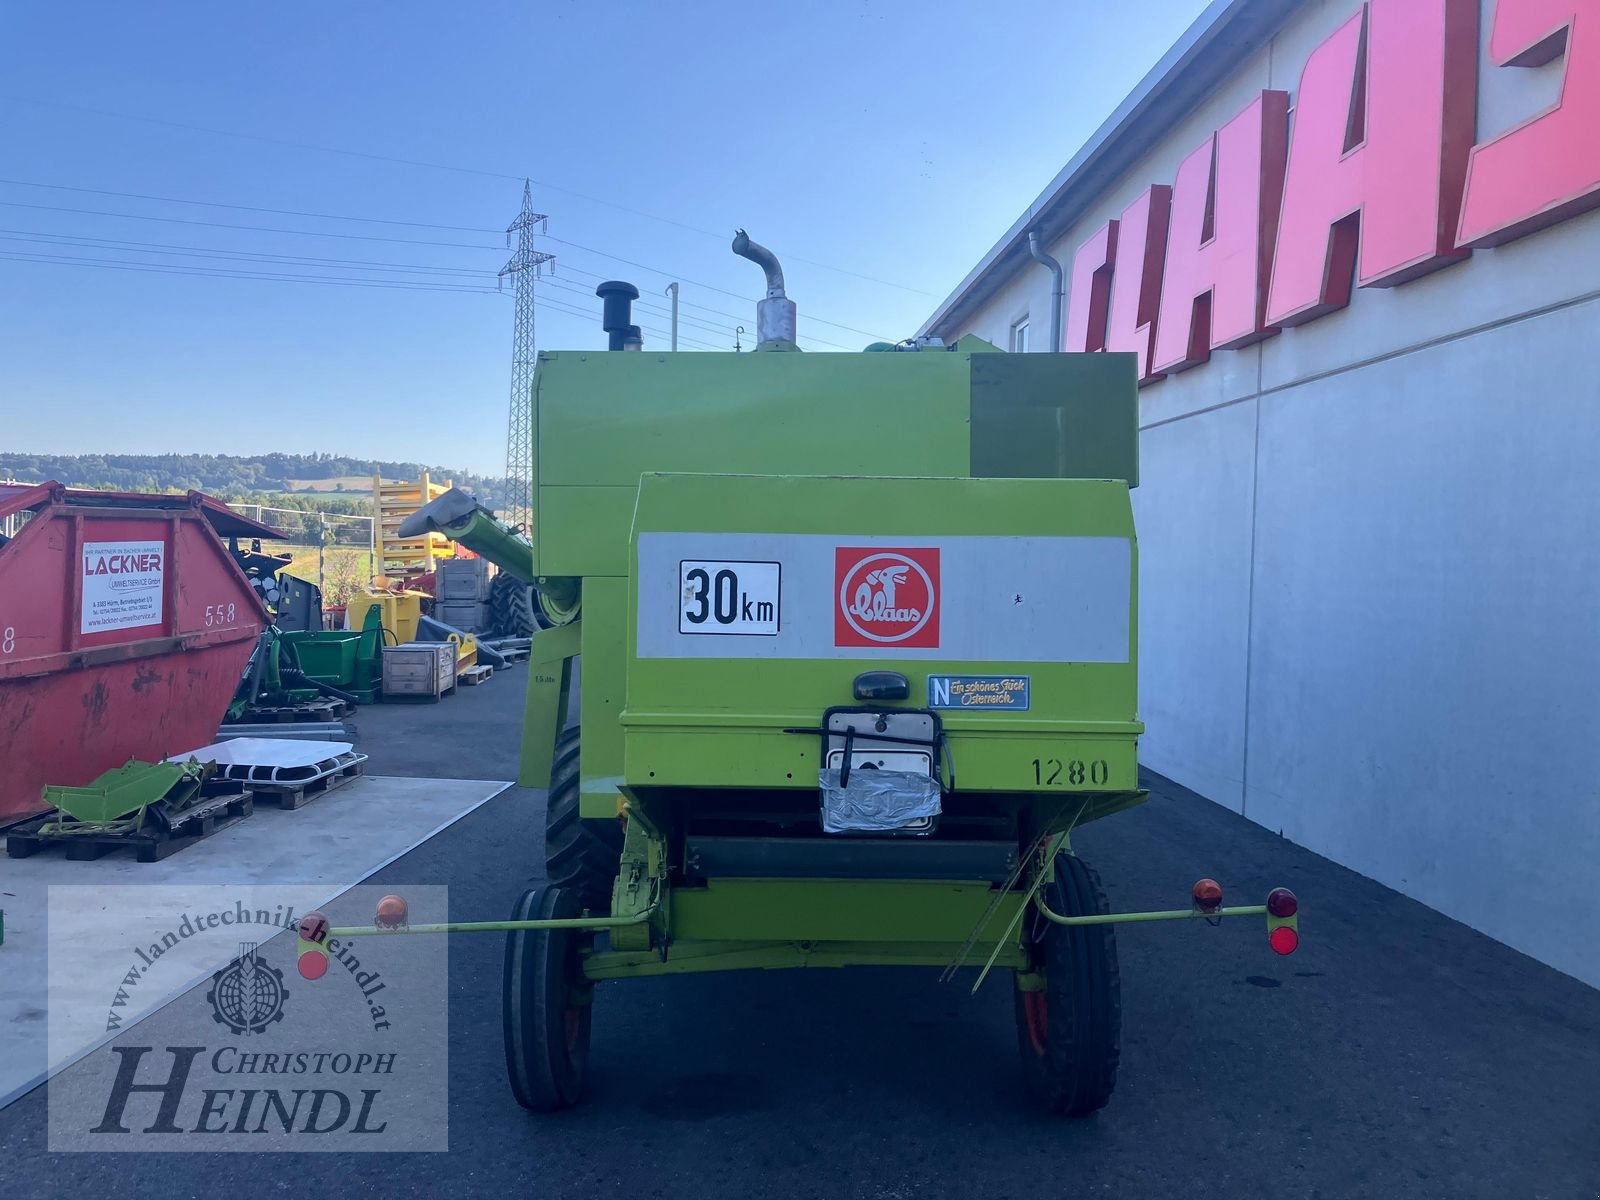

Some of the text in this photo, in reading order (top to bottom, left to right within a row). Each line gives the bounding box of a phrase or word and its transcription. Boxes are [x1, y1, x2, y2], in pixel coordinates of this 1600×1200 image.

[85, 554, 161, 575] LACKNER
[112, 579, 147, 588] UMWELTSERVICE
[205, 602, 235, 627] 558
[933, 678, 950, 706] N
[950, 679, 1025, 694] Ein schönes Stück
[961, 692, 1014, 706] Österreich
[1032, 759, 1108, 785] 1280
